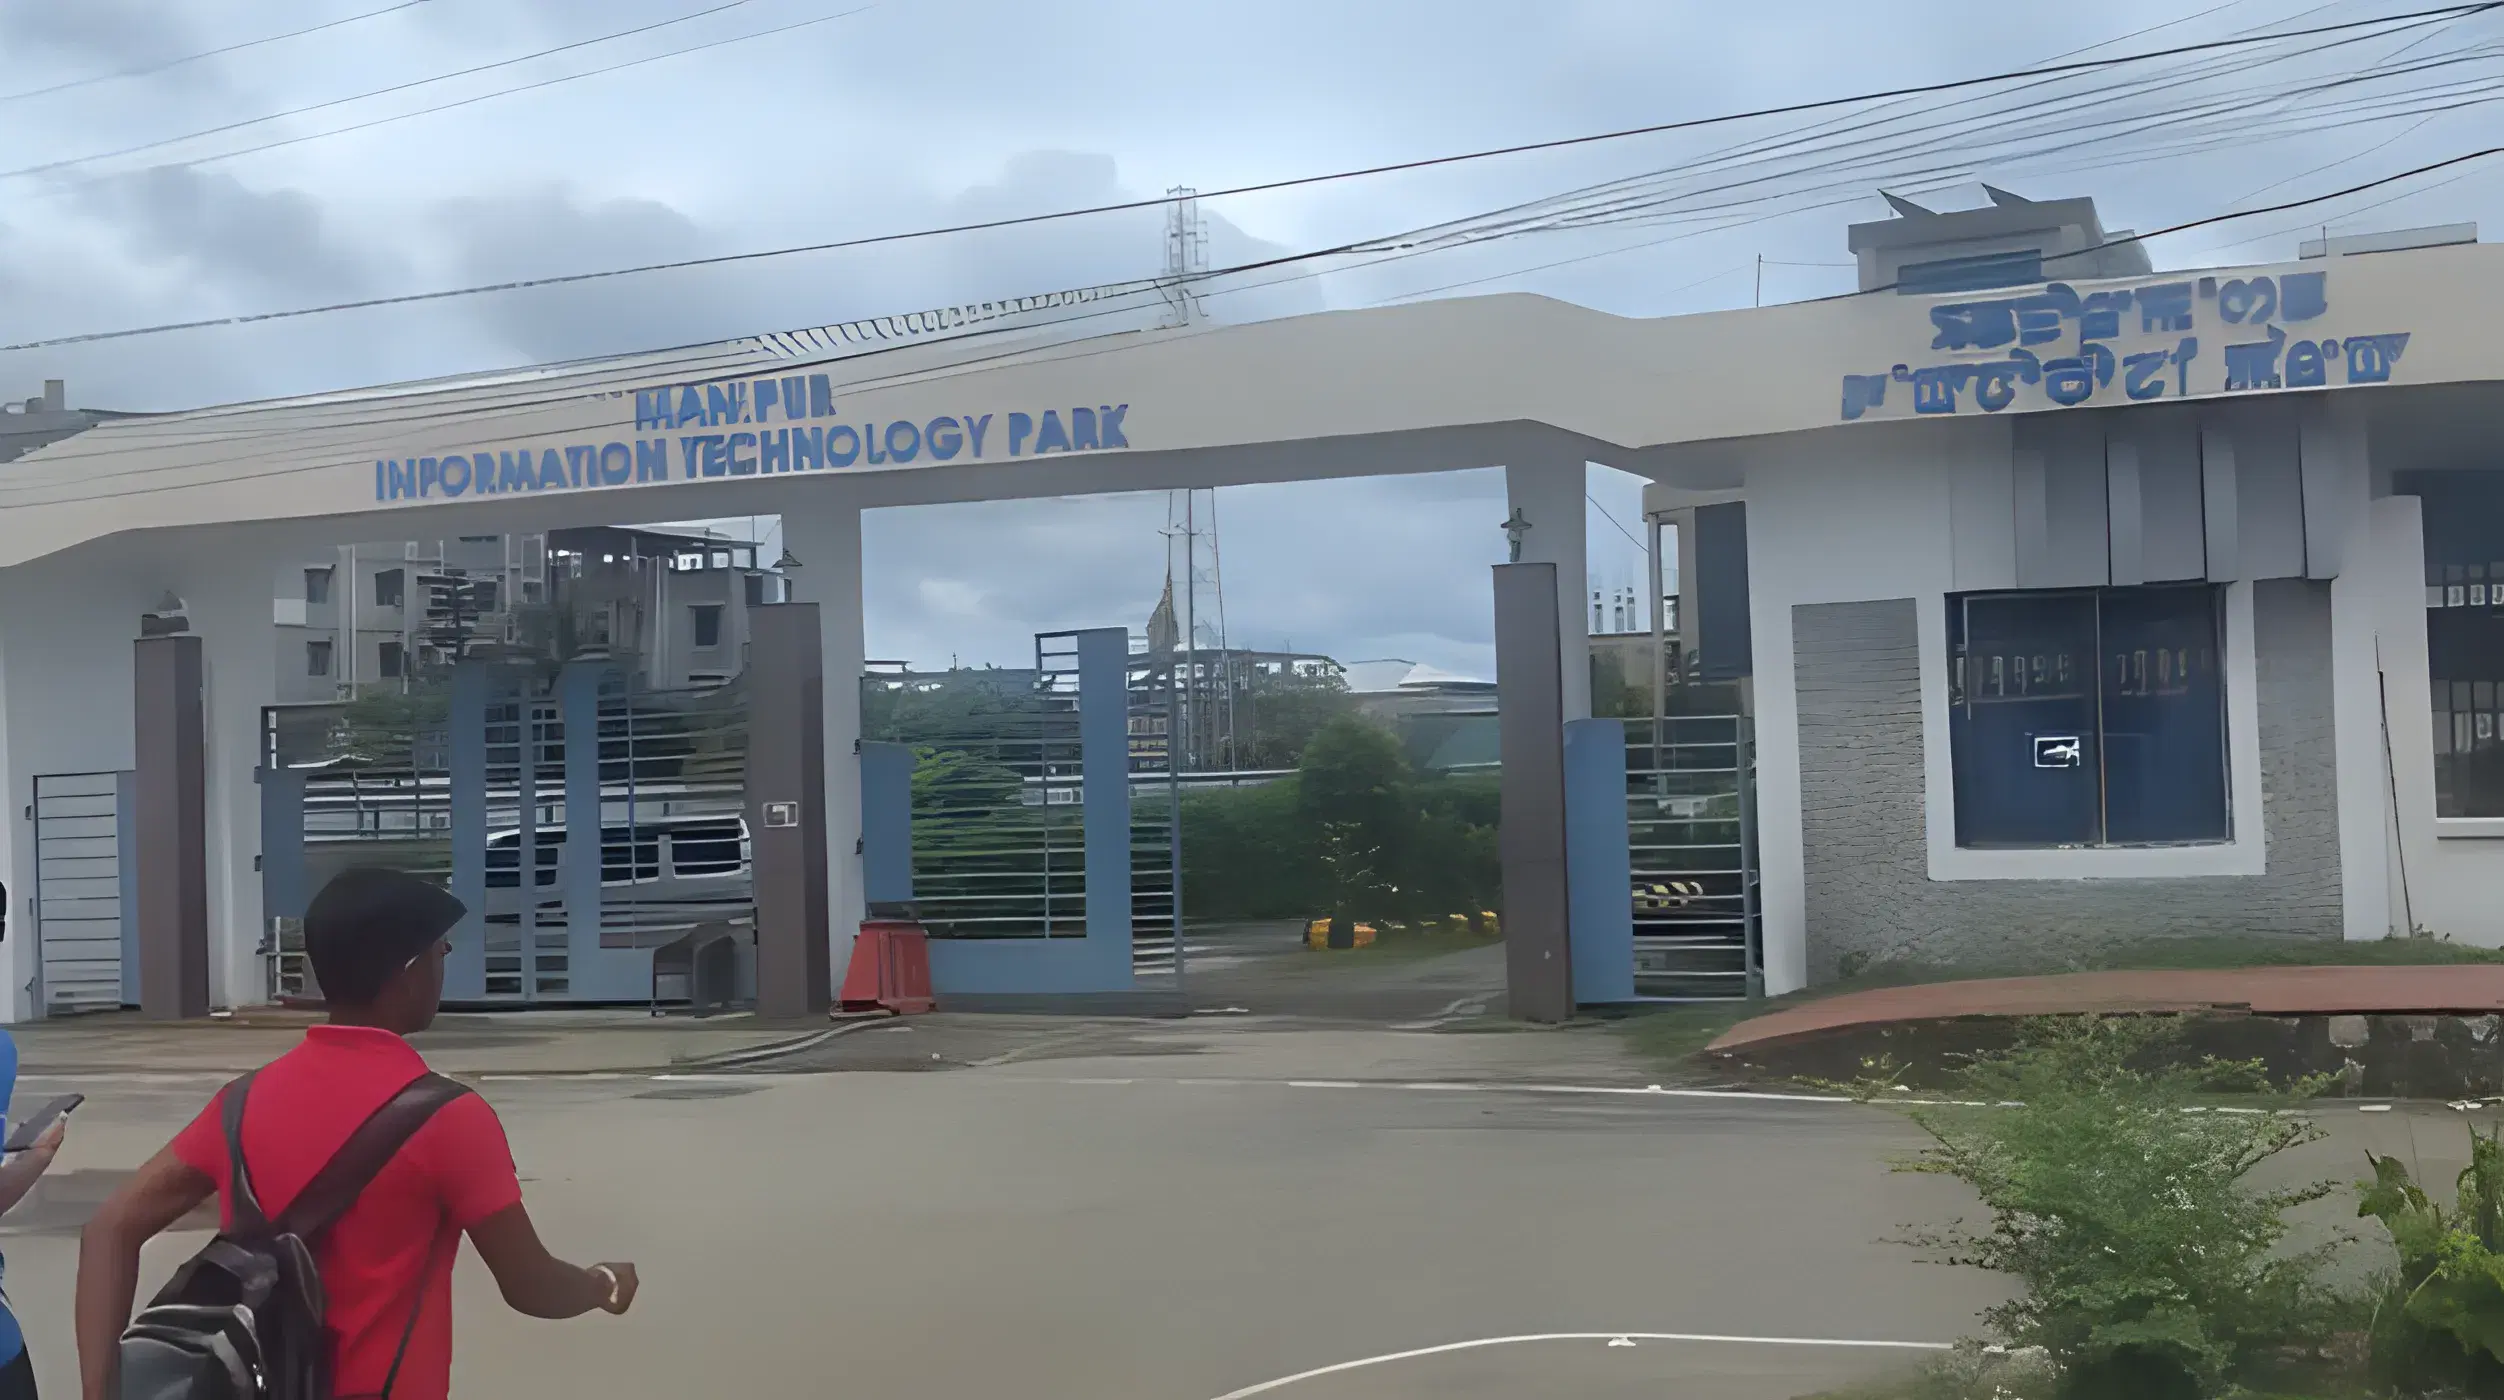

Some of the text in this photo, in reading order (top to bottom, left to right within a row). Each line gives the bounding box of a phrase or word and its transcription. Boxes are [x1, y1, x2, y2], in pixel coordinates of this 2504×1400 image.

[635, 373, 837, 432] MANIPUR
[678, 413, 994, 479] TECHNOLOGY
[1008, 403, 1130, 457] PARK
